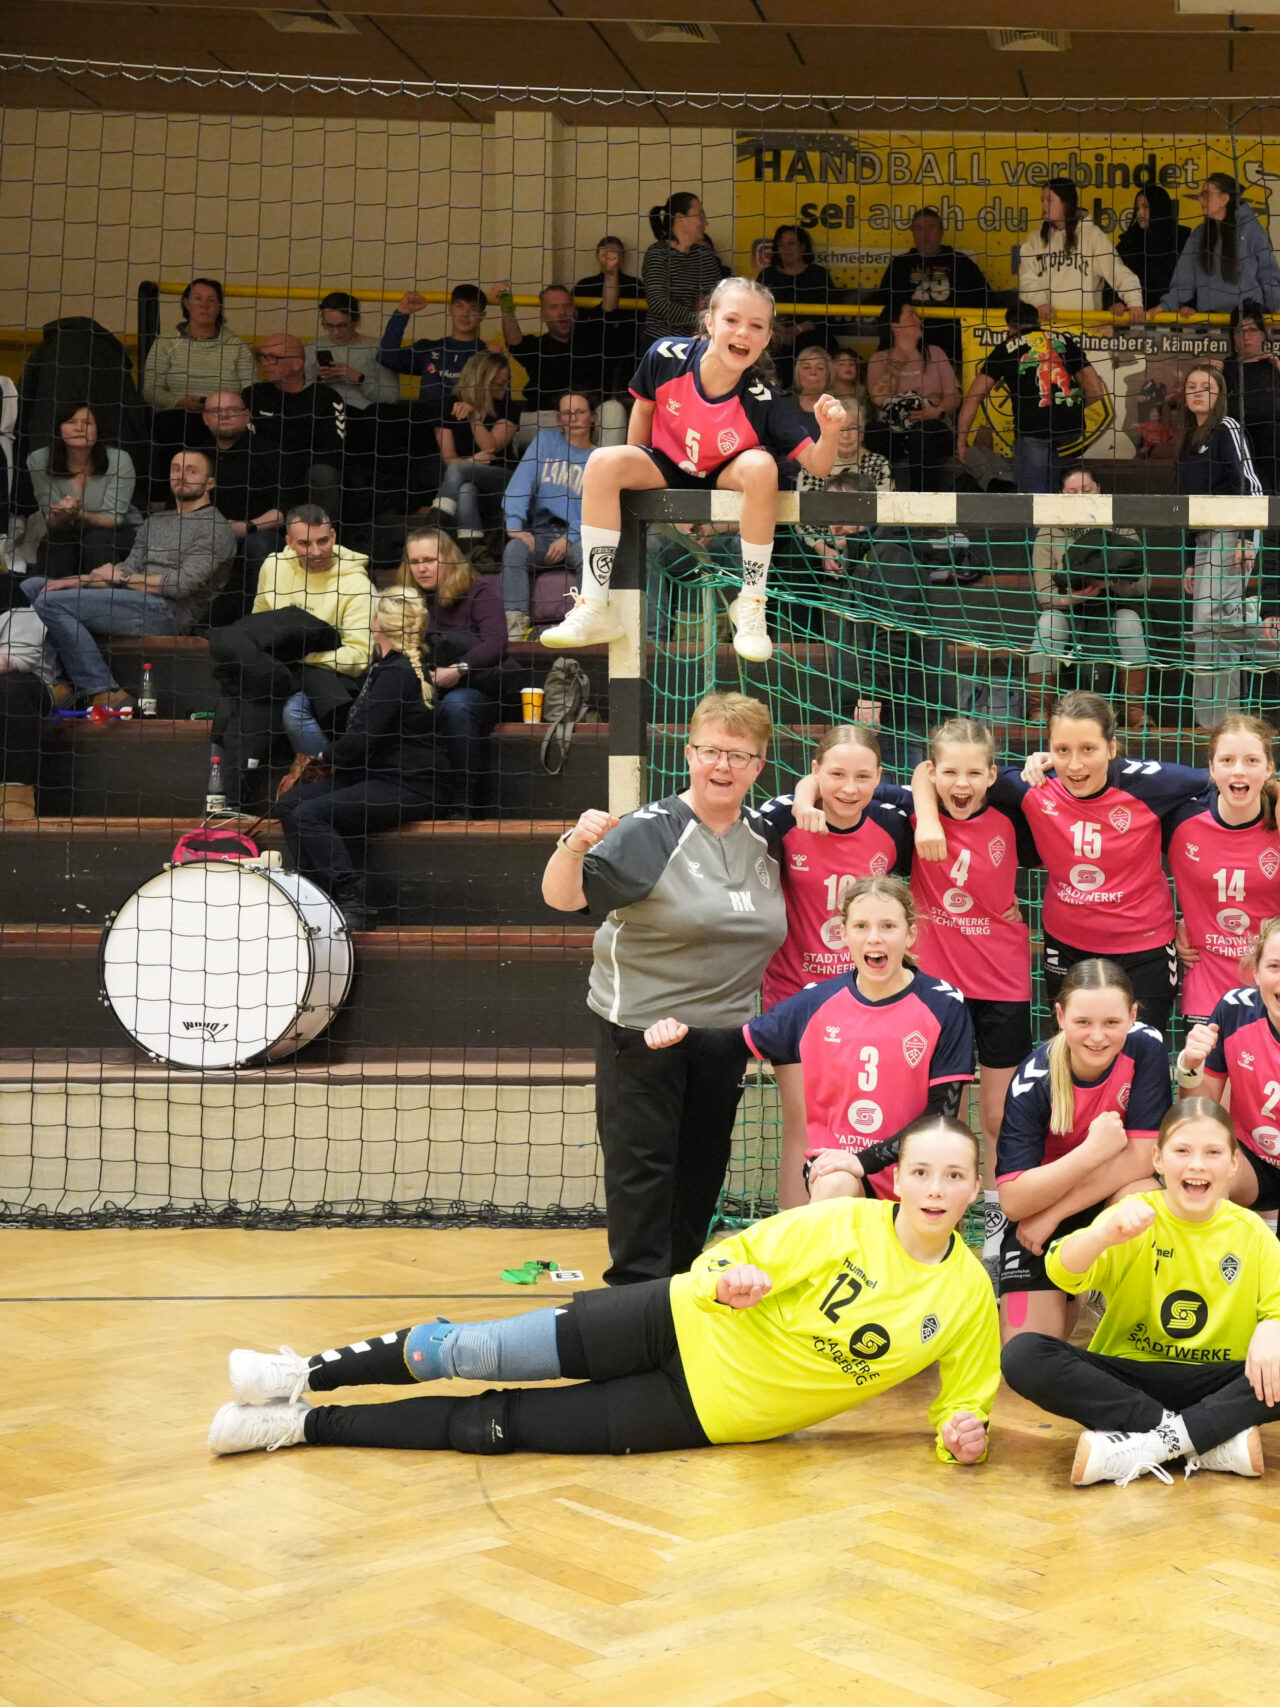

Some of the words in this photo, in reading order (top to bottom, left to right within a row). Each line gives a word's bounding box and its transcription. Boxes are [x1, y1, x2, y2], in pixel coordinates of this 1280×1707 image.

[753, 148, 991, 185] HANDBALL
[1002, 151, 1200, 189] verbindet
[800, 196, 856, 230] sei
[867, 197, 964, 232] auh
[977, 197, 1029, 232] du
[816, 252, 890, 265] schneeber
[1071, 334, 1159, 354] chneeberg,
[1162, 335, 1228, 357] kämpfen
[685, 428, 702, 464] 5
[1069, 821, 1102, 859] 15
[950, 848, 971, 887] 4
[1212, 868, 1246, 902] 14
[803, 951, 851, 963] STADTW
[857, 1046, 879, 1092] 3
[843, 1257, 878, 1289] hummel
[819, 1272, 863, 1324] 12
